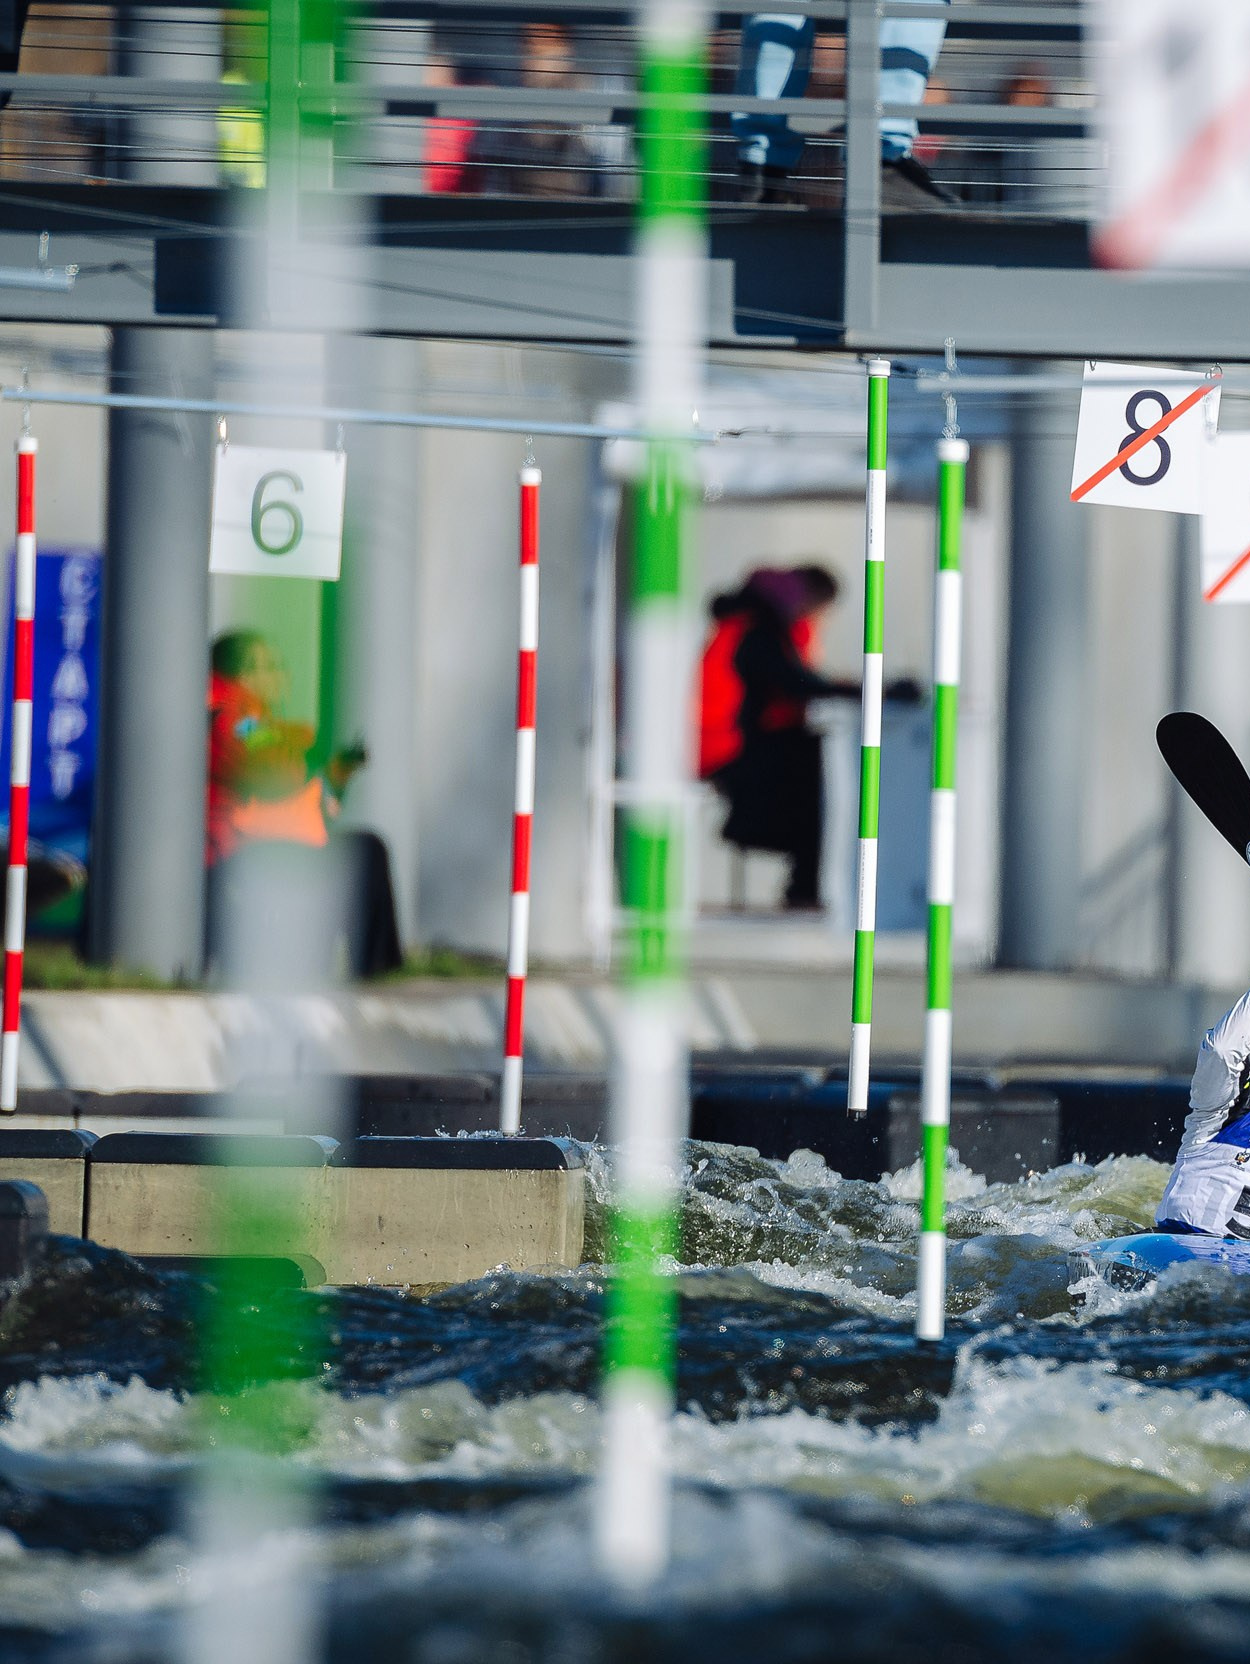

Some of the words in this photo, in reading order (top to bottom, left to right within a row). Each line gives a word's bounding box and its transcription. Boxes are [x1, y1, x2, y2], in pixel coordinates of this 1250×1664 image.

[1117, 389, 1172, 486] 8
[250, 470, 304, 555] 6
[48, 553, 97, 800] СТАРТ
